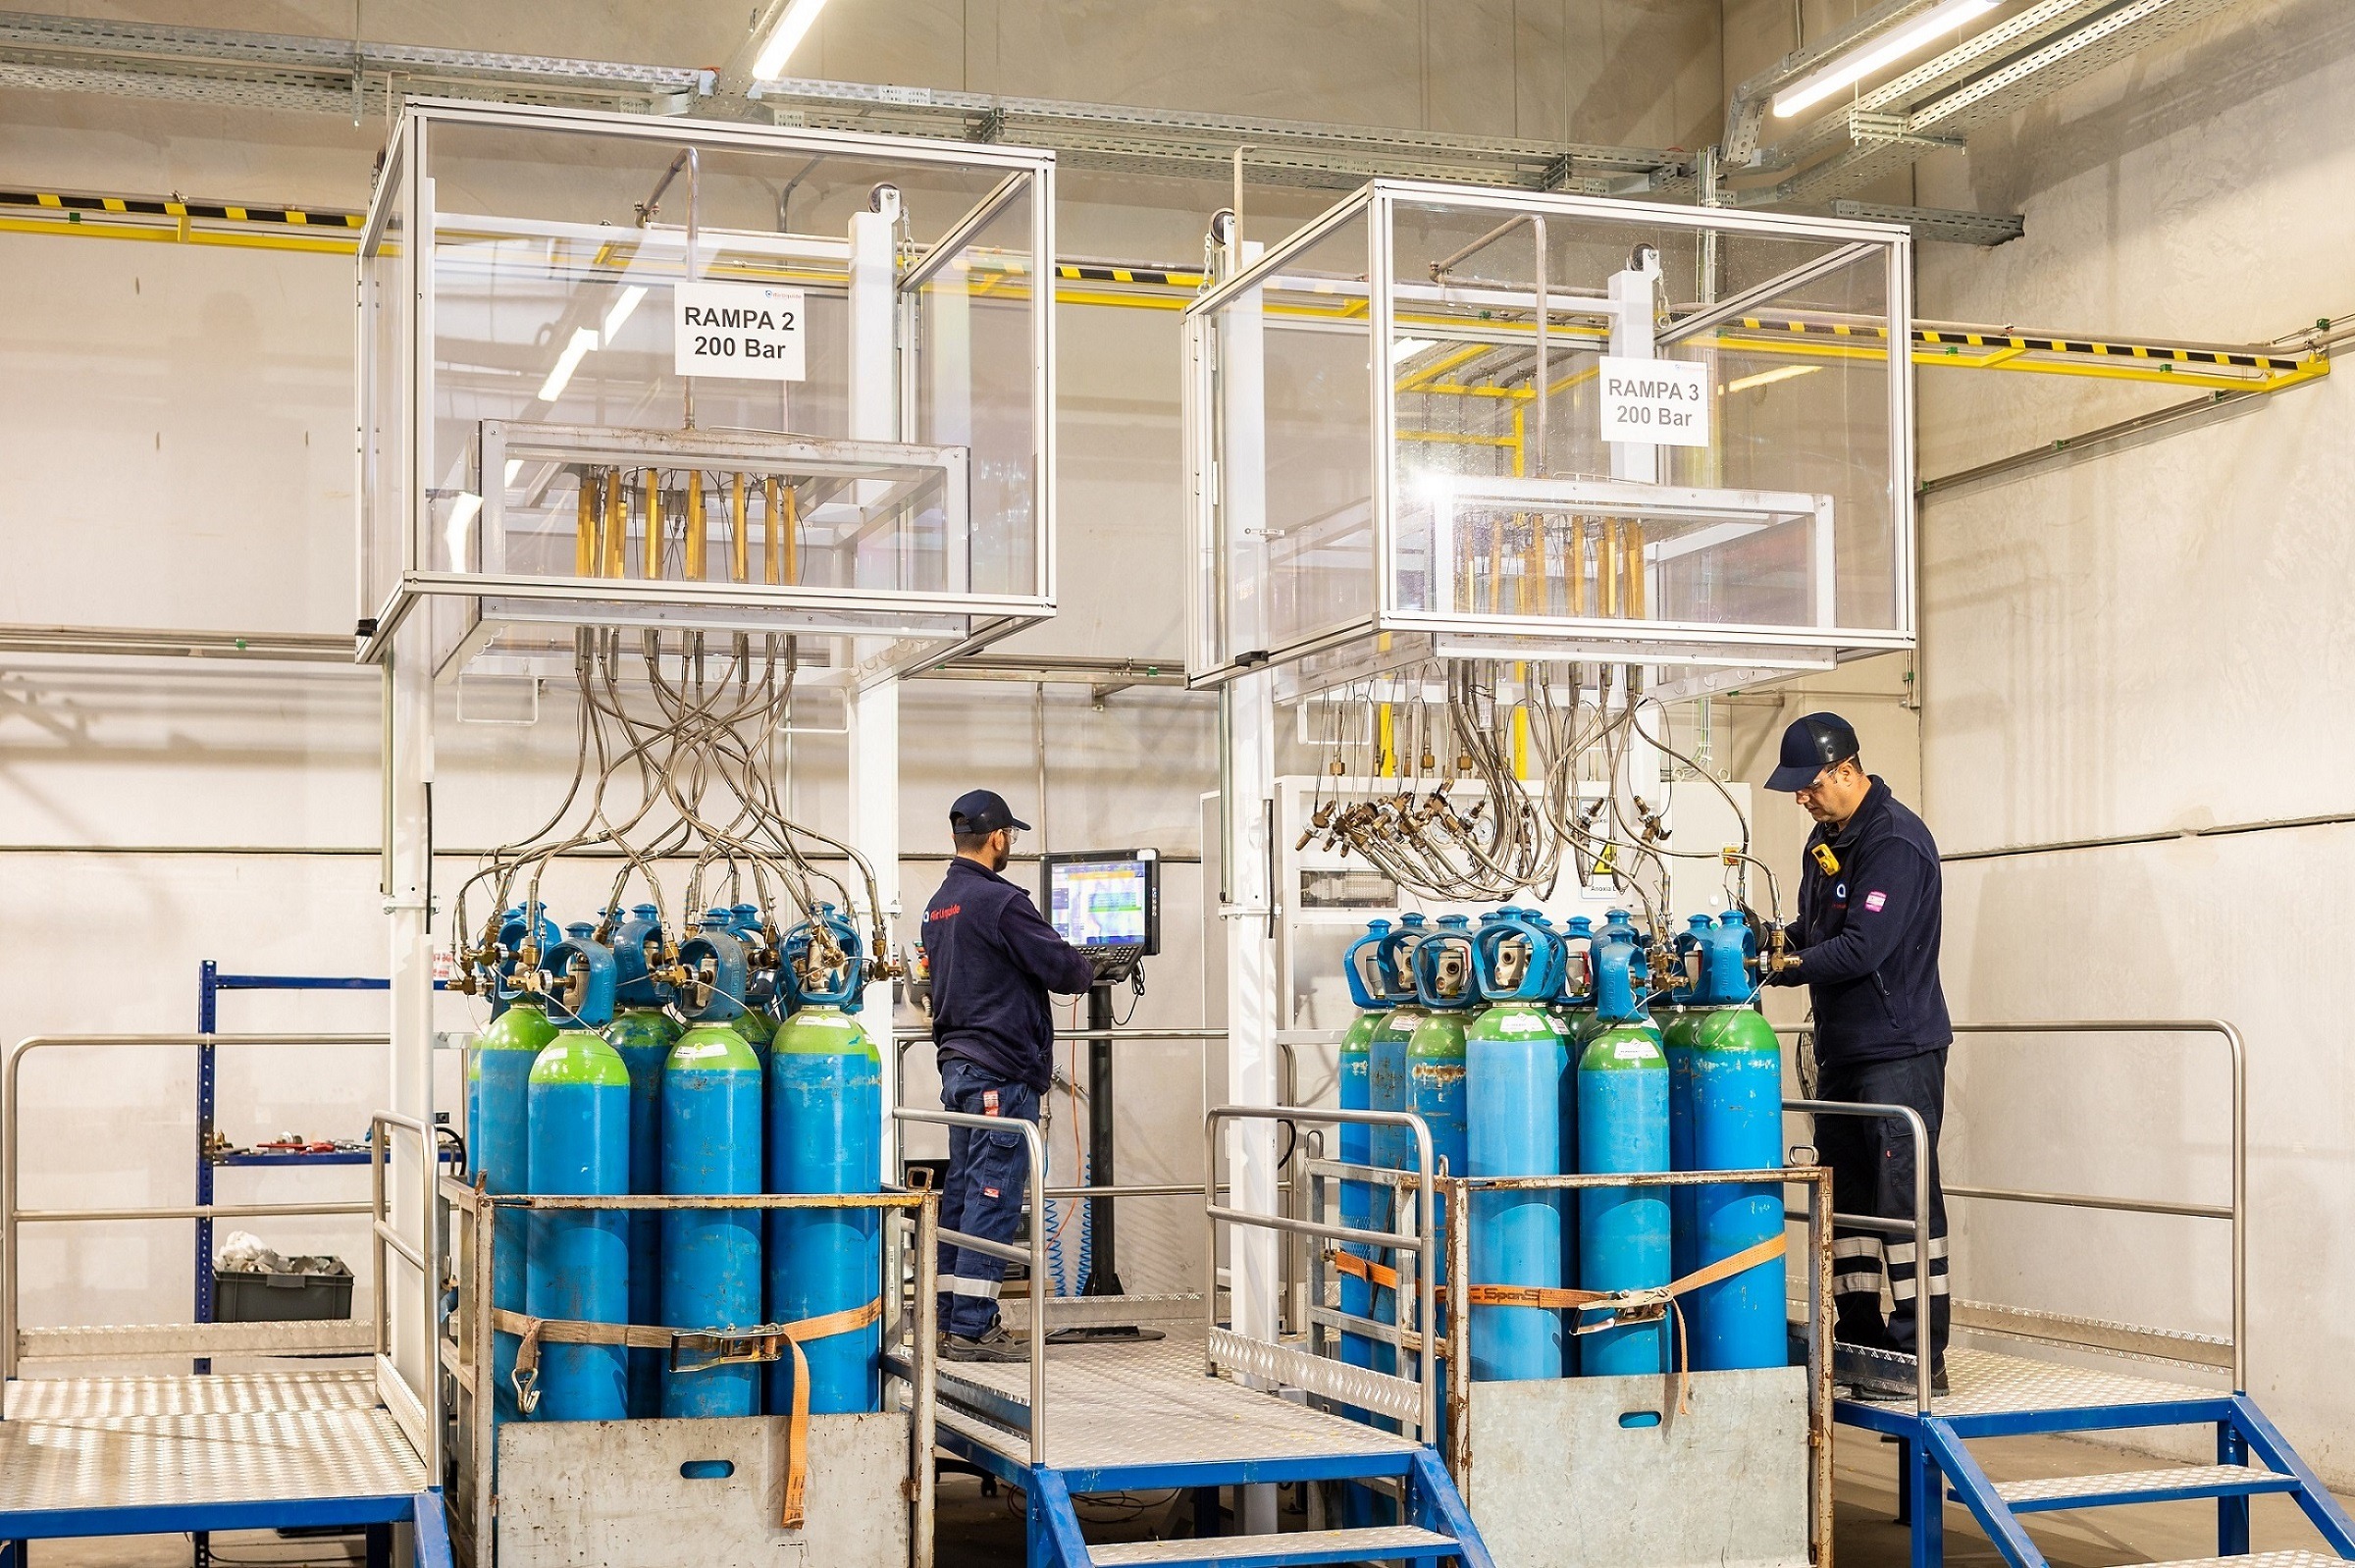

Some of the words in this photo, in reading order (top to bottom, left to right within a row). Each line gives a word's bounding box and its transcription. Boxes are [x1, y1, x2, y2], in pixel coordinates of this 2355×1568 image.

[685, 306, 775, 330] RAMPA
[781, 312, 795, 332] 2
[694, 336, 736, 356] 200
[745, 339, 787, 359] Bar
[1608, 378, 1684, 400] RAMPA
[1688, 383, 1700, 401] 3
[1616, 404, 1651, 424] 200
[1658, 407, 1693, 427] Bar
